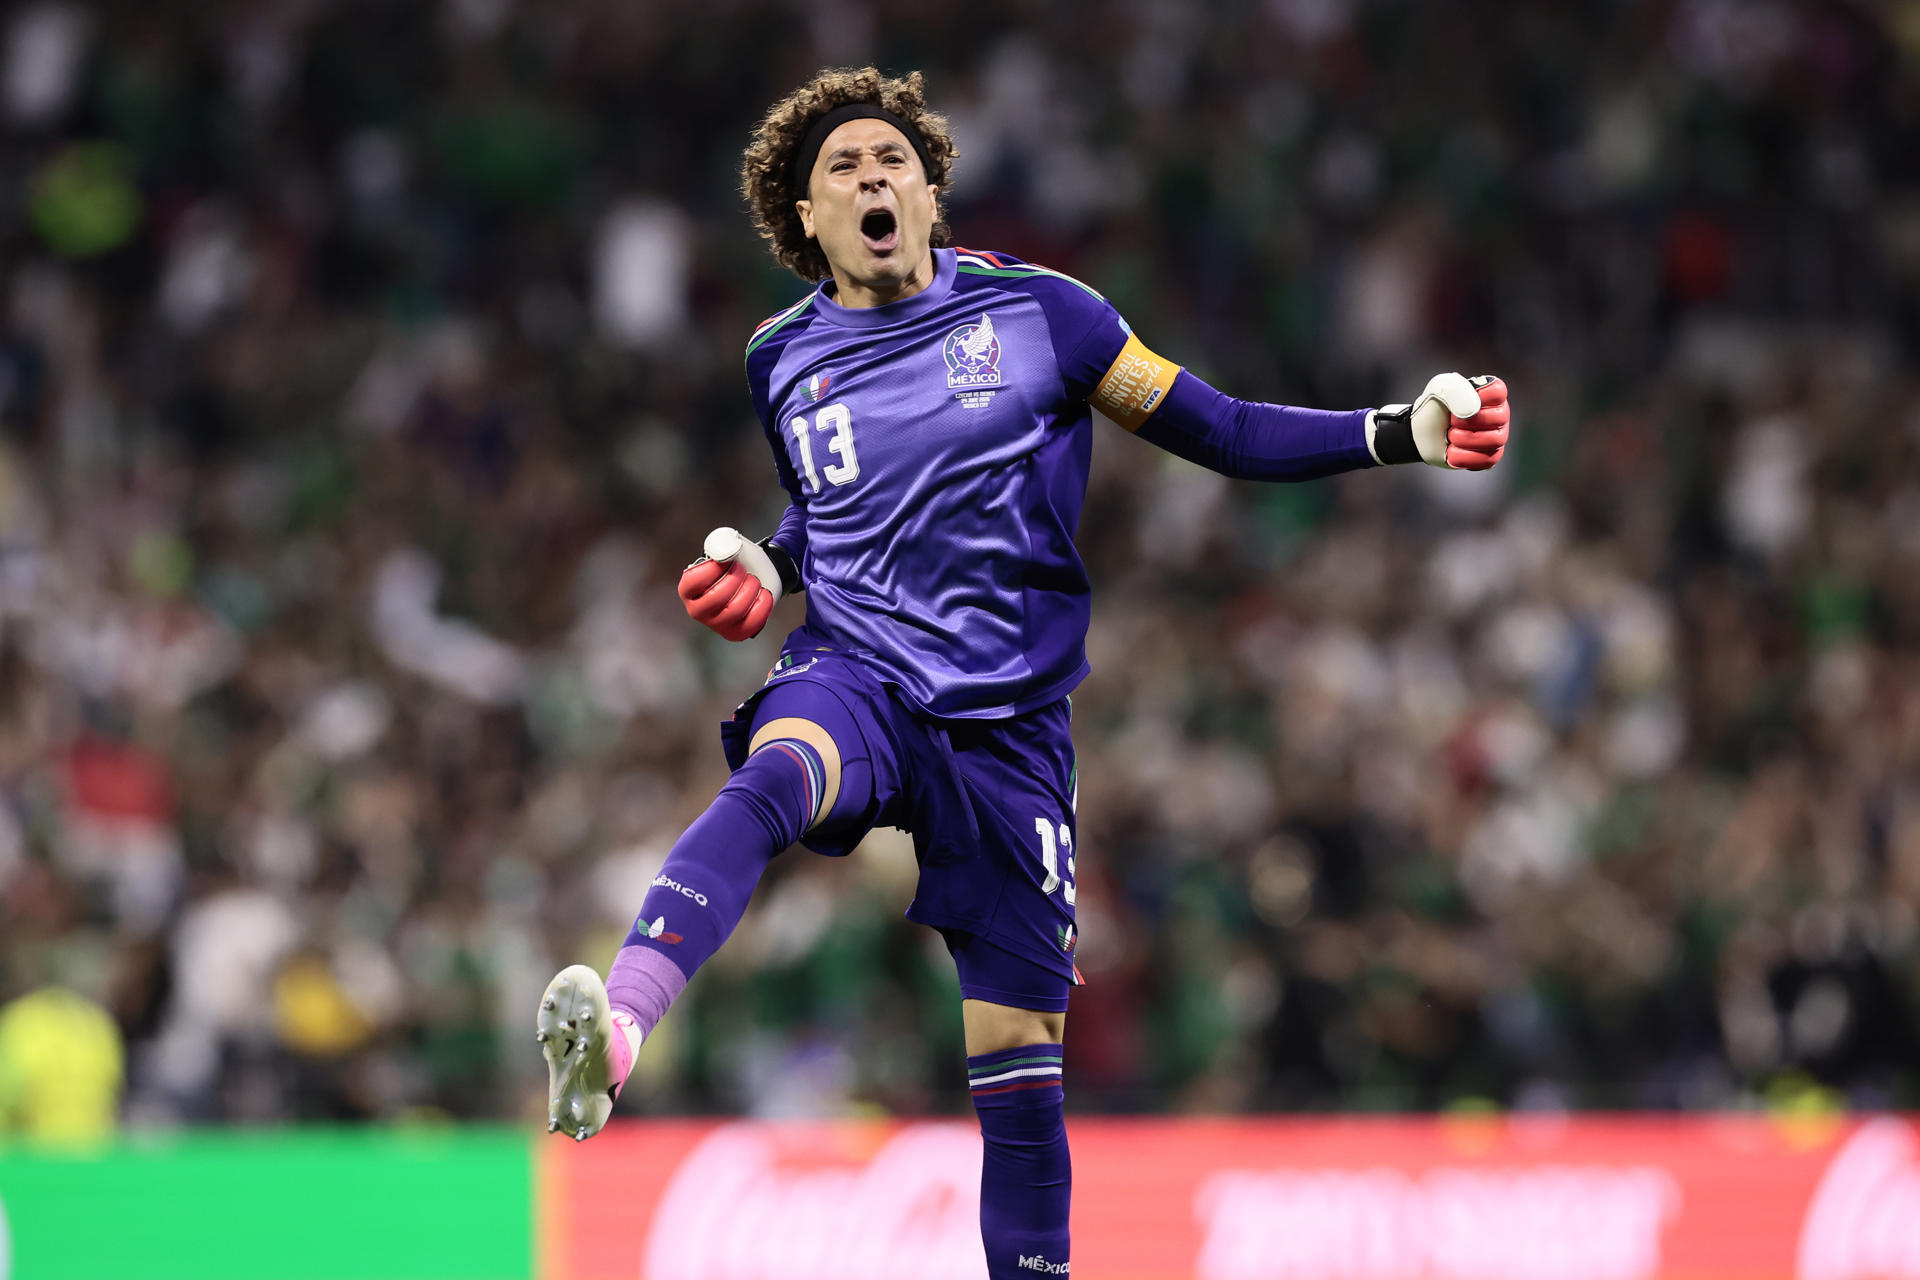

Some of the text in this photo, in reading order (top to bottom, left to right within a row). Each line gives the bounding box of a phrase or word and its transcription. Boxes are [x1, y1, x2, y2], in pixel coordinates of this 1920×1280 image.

[950, 373, 998, 385] MÉXICO
[1097, 353, 1137, 401] FOOTBALL
[1106, 358, 1150, 409] UNITES
[1131, 361, 1163, 402] World
[1142, 389, 1161, 410] FIFA
[791, 404, 860, 494] 13
[652, 874, 708, 907] MÉXICO
